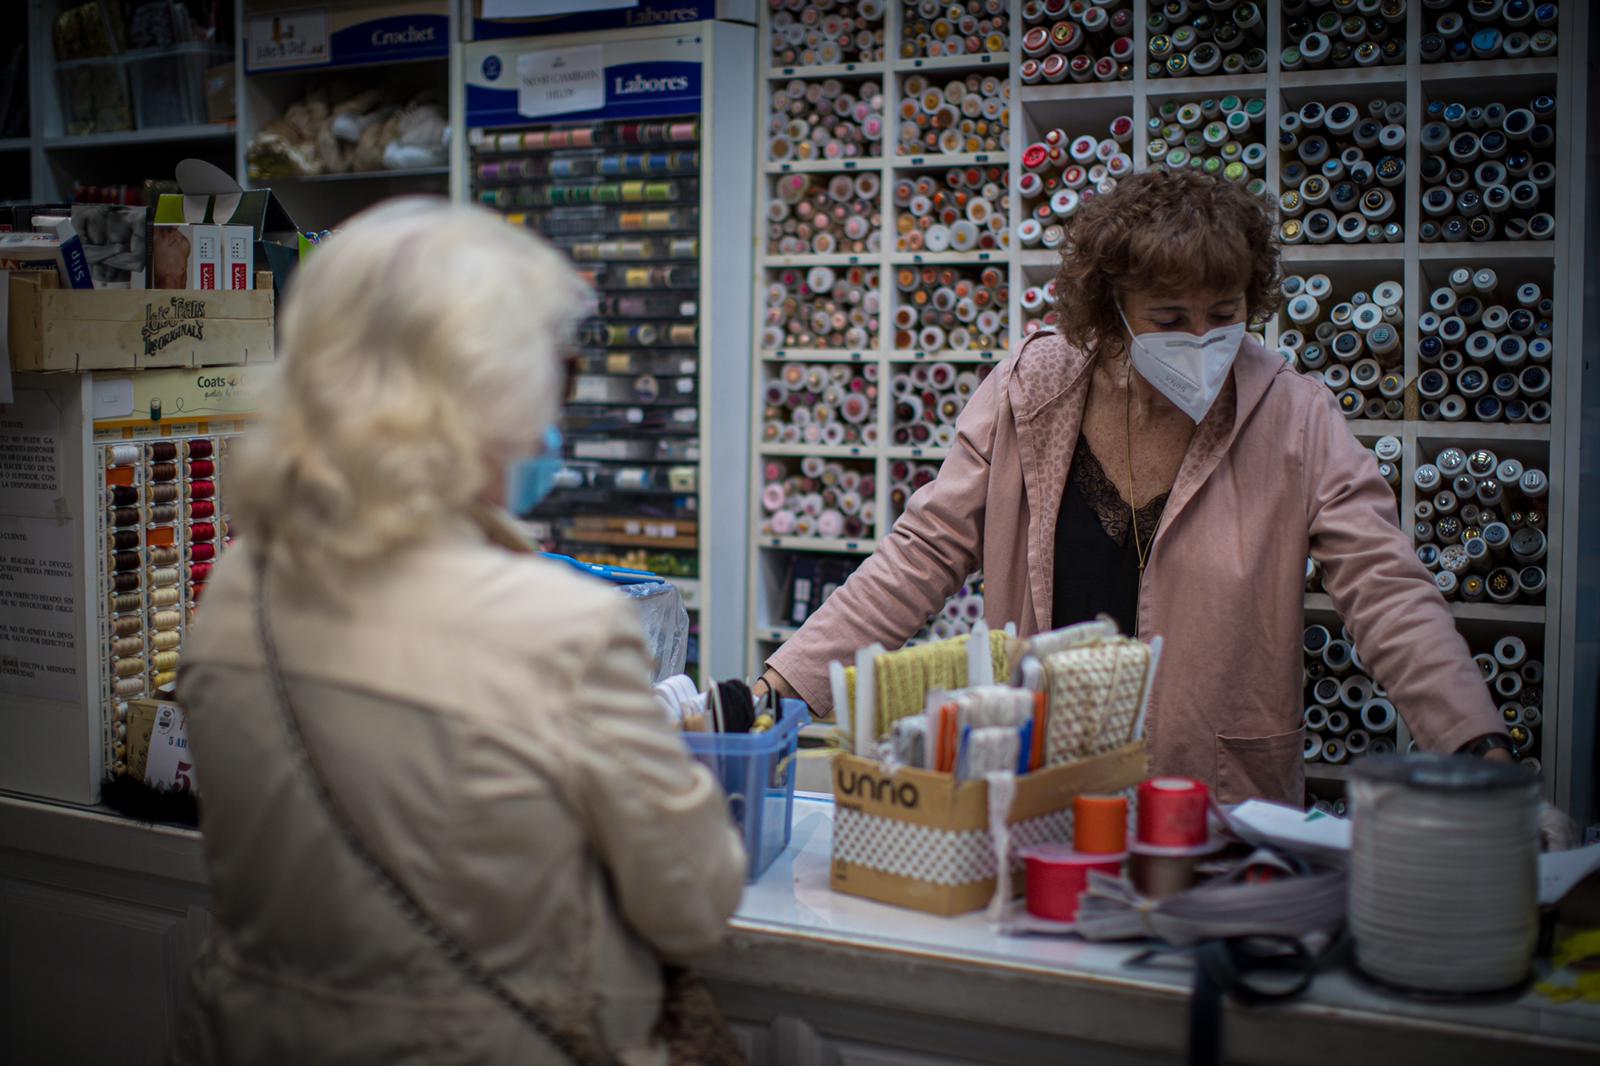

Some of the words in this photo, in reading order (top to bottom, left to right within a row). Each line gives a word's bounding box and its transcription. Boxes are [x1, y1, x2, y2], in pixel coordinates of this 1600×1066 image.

[626, 6, 698, 25] Labores
[371, 25, 435, 46] Crochet
[615, 74, 688, 95] Labores
[71, 250, 84, 282] Slip
[197, 376, 225, 388] Coats
[174, 760, 192, 792] 5
[838, 768, 918, 808] unno
